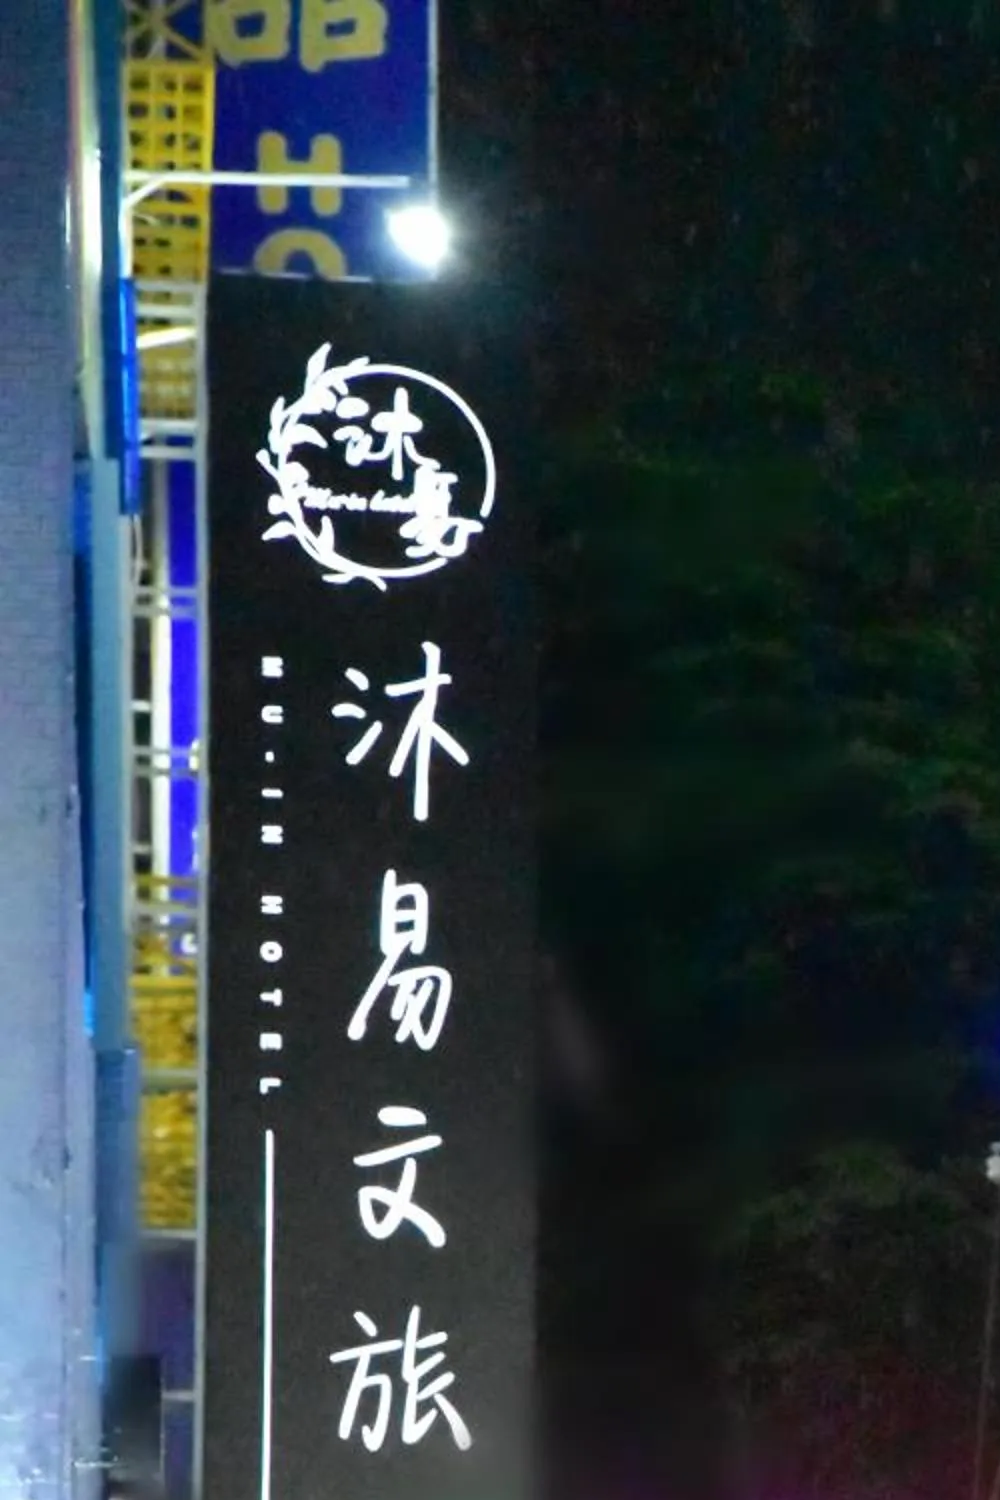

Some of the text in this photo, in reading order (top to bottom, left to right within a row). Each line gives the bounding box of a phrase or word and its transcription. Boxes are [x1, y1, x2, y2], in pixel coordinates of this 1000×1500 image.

[259, 894, 283, 1095] HOTEL
[329, 640, 473, 1453] 沐易文旅
